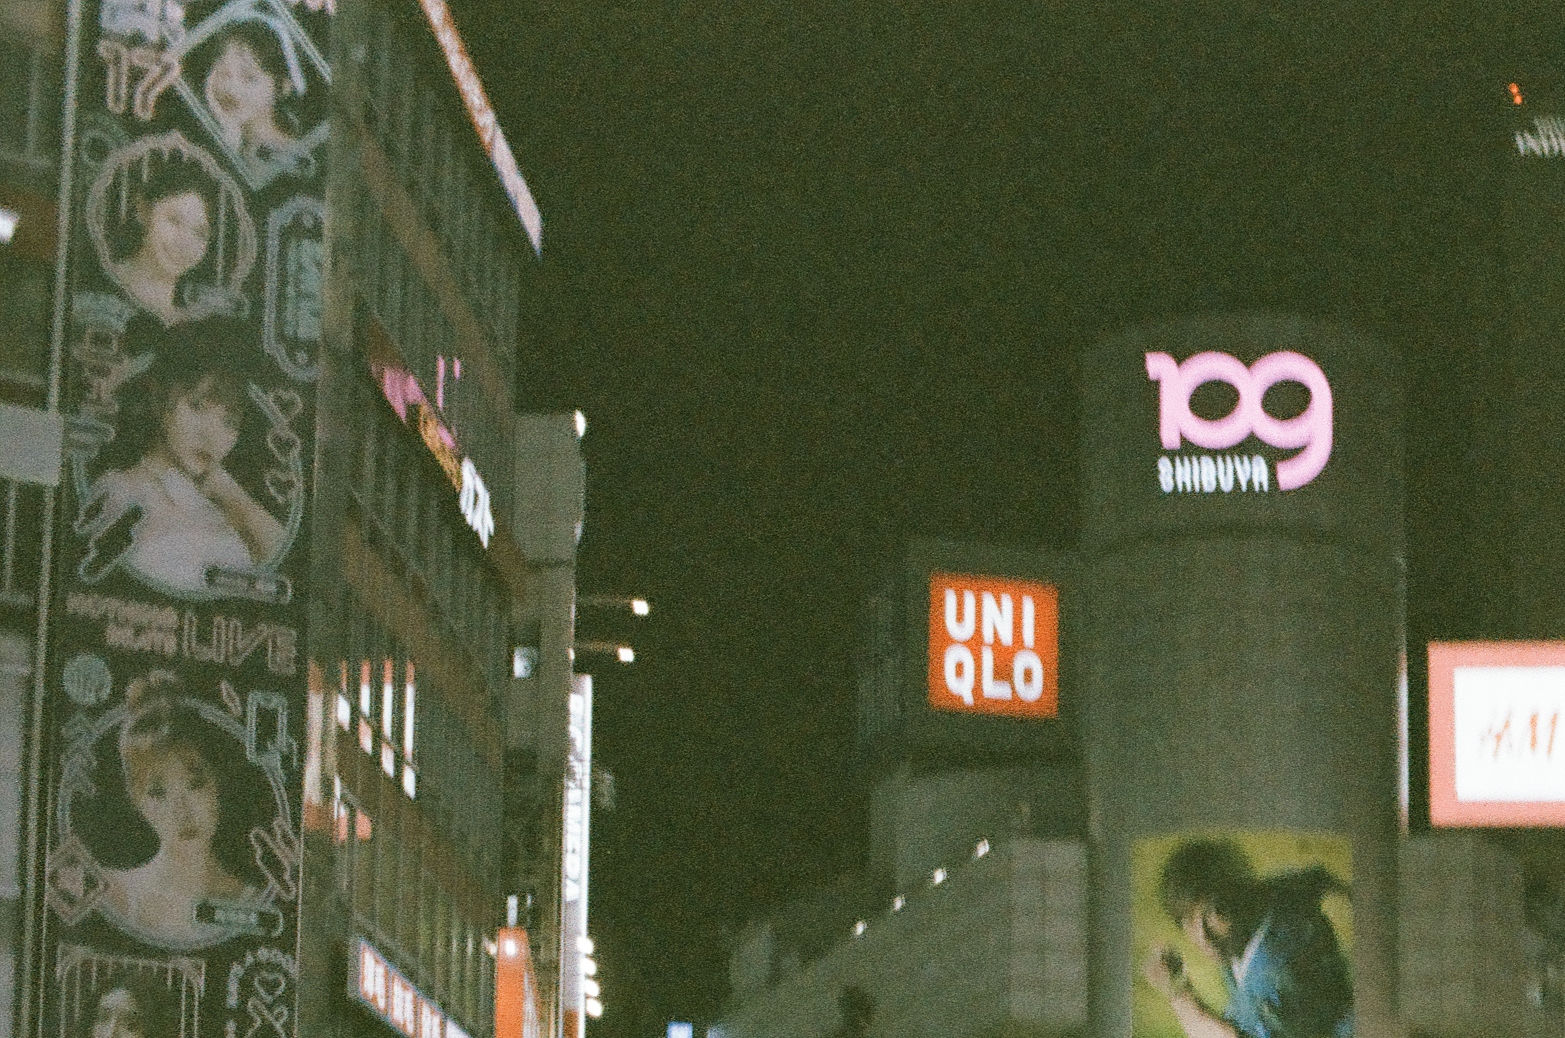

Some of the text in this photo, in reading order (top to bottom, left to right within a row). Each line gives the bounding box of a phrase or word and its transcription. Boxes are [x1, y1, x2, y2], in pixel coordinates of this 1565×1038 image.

[1145, 350, 1335, 491] 109
[1157, 454, 1270, 494] SHIBUYA
[943, 587, 1037, 651] UNI
[943, 645, 1043, 706] QLO
